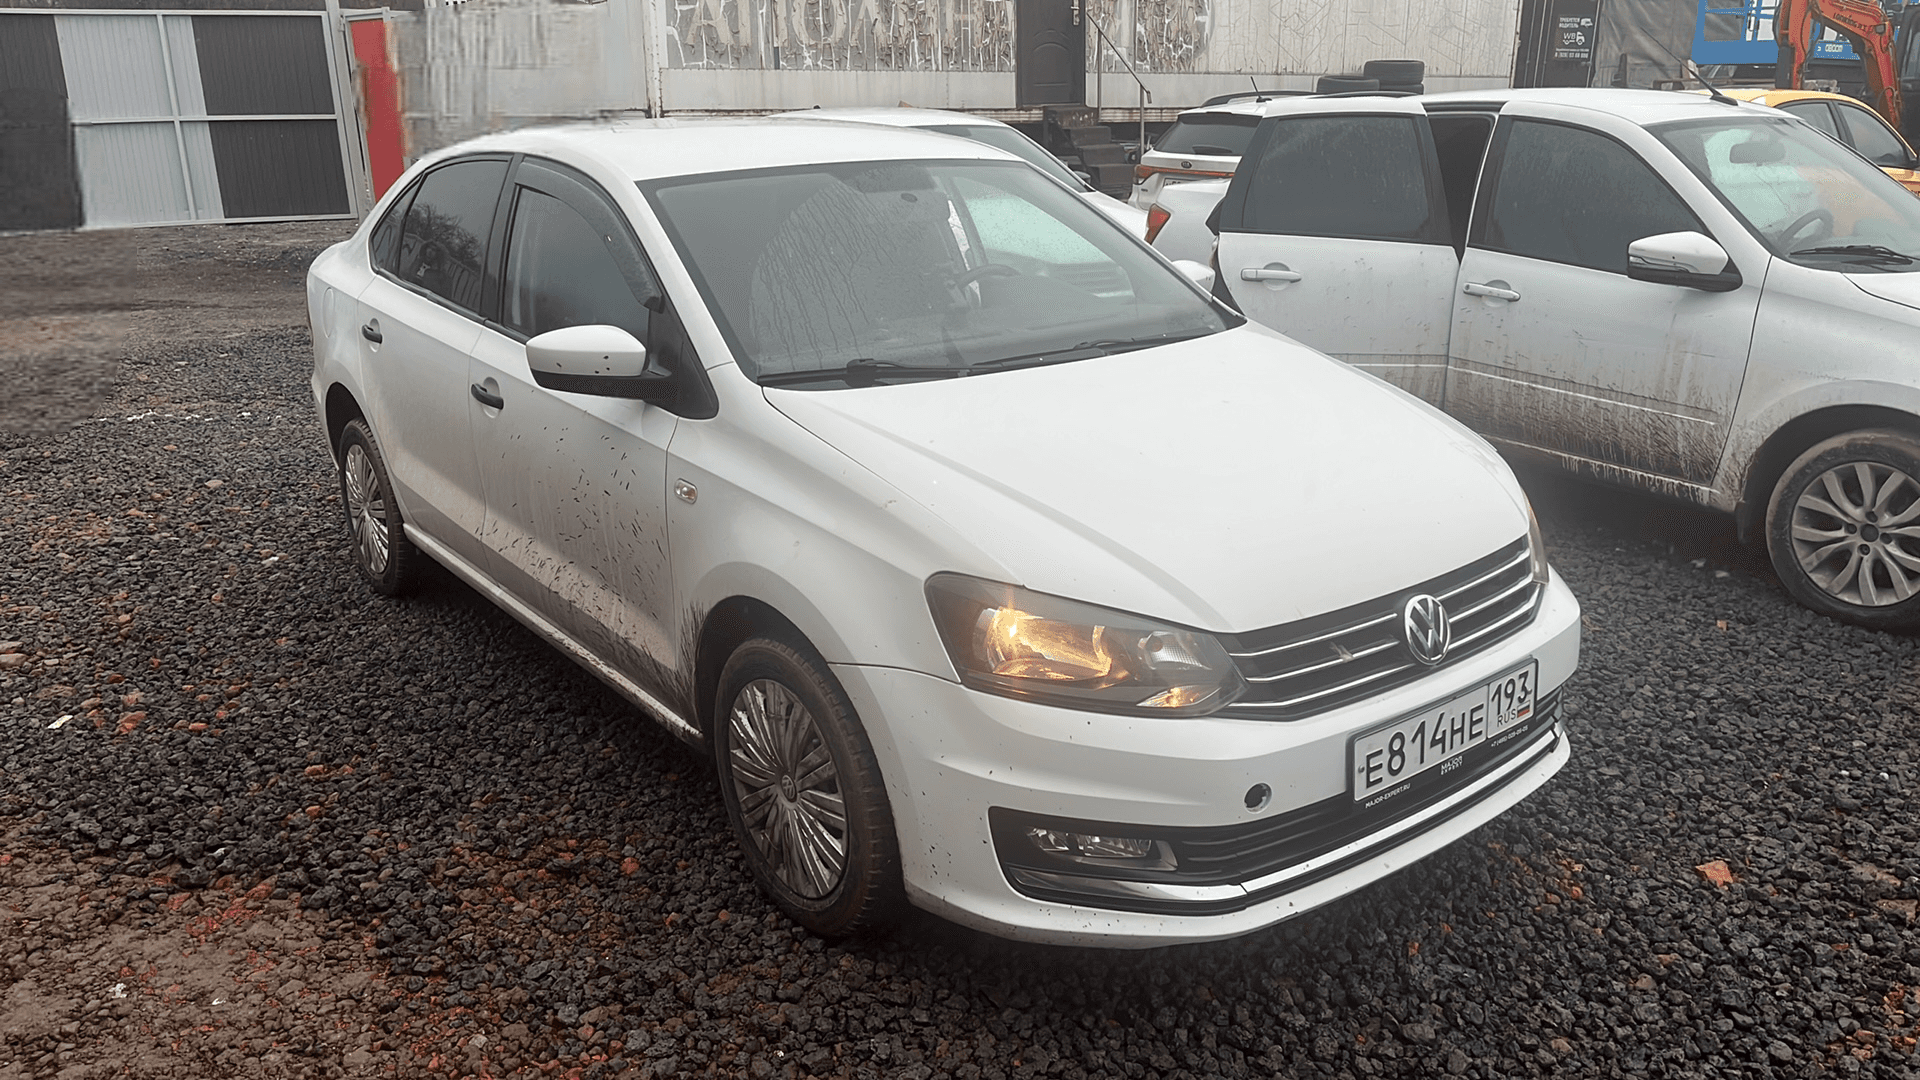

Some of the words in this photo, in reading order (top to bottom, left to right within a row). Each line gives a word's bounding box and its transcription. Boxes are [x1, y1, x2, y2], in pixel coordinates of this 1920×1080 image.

[1491, 670, 1532, 716] 193
[1496, 708, 1517, 727] RUS
[1441, 755, 1463, 771] MAJOR
[1441, 762, 1463, 776] EXPERT
[1365, 783, 1411, 809] MAJOR-EXPERT.RU
